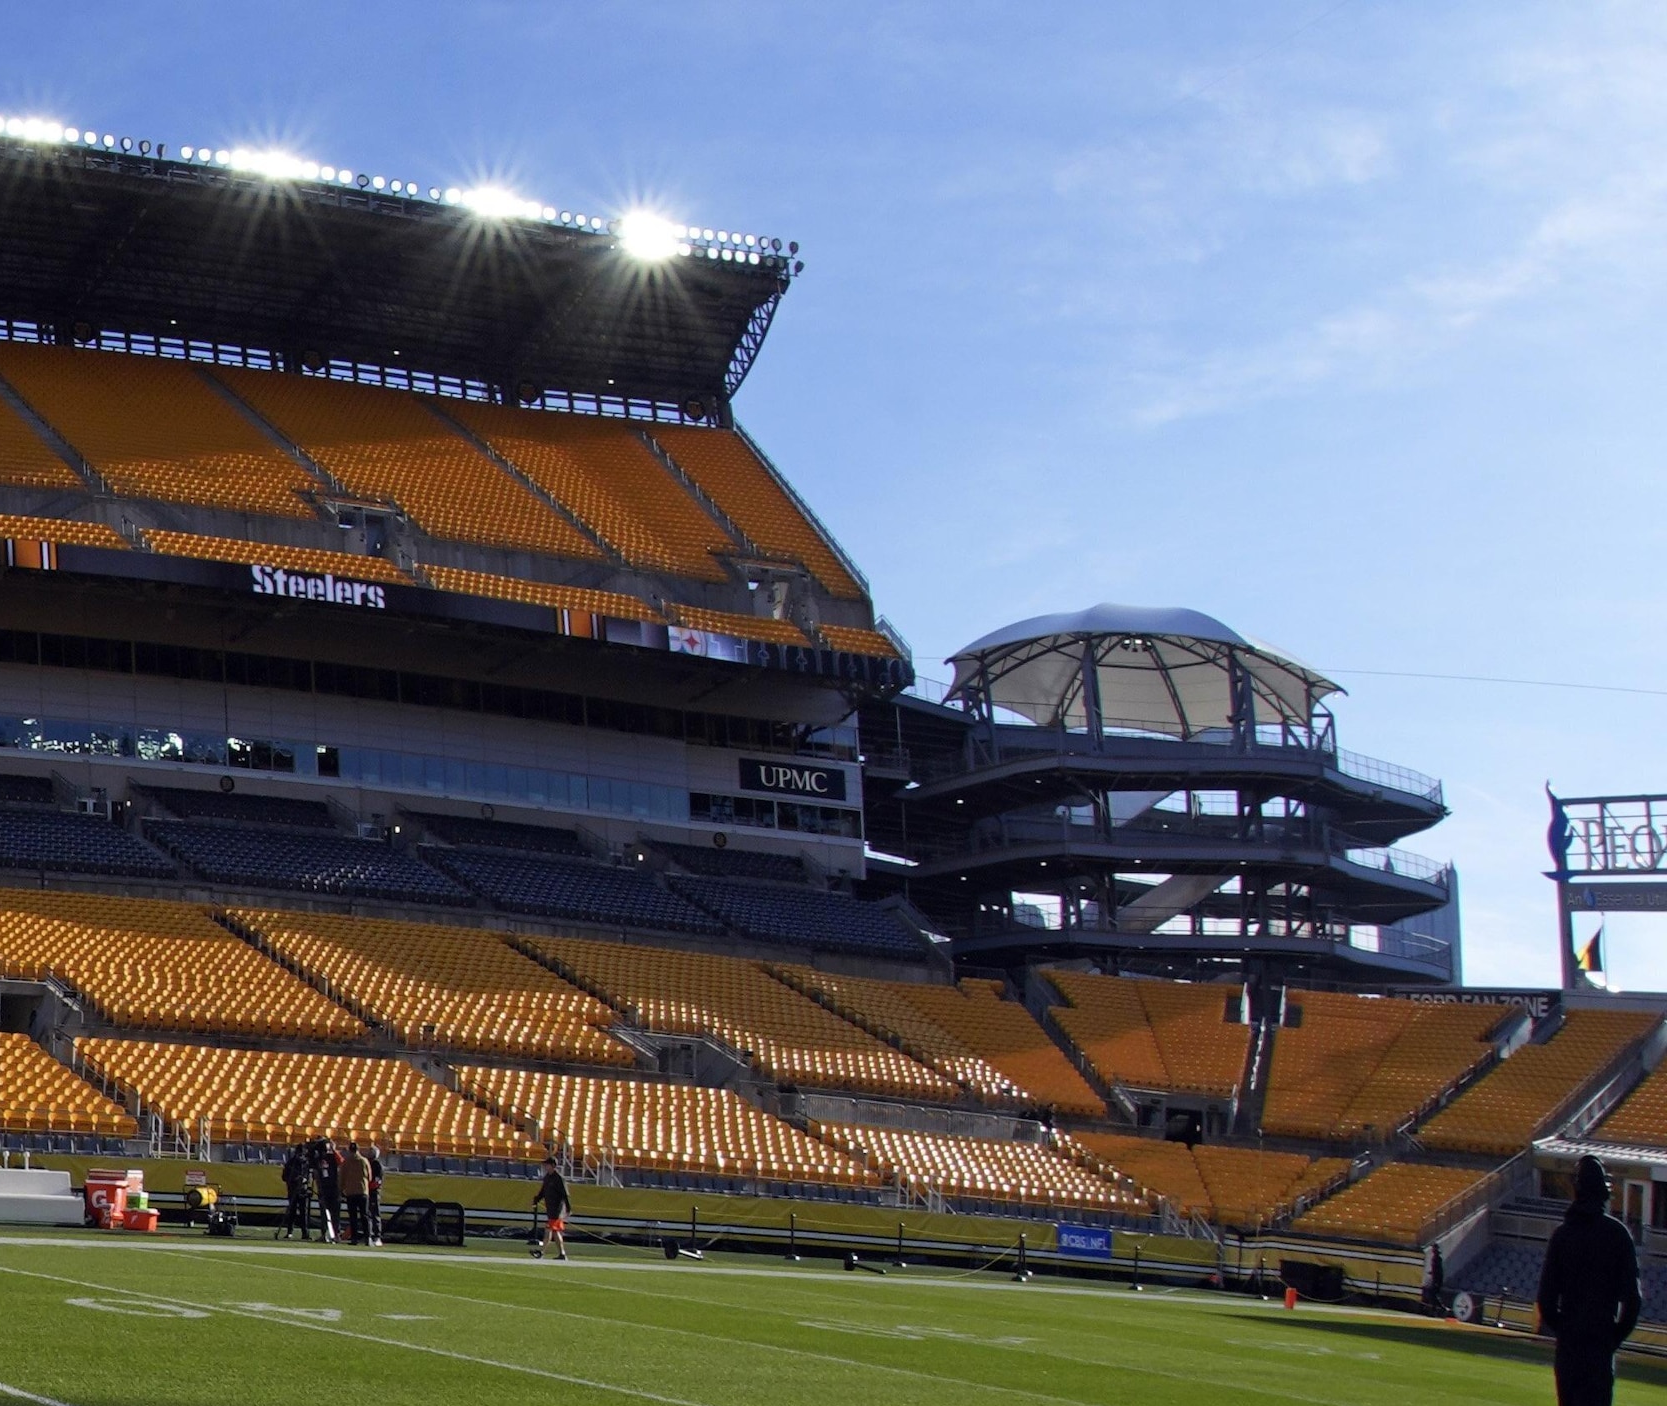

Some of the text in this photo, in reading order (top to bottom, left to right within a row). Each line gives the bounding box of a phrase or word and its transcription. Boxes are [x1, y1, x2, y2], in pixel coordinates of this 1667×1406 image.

[252, 565, 385, 609] Steelers
[759, 764, 828, 793] UPMC
[1579, 819, 1667, 871] PEO
